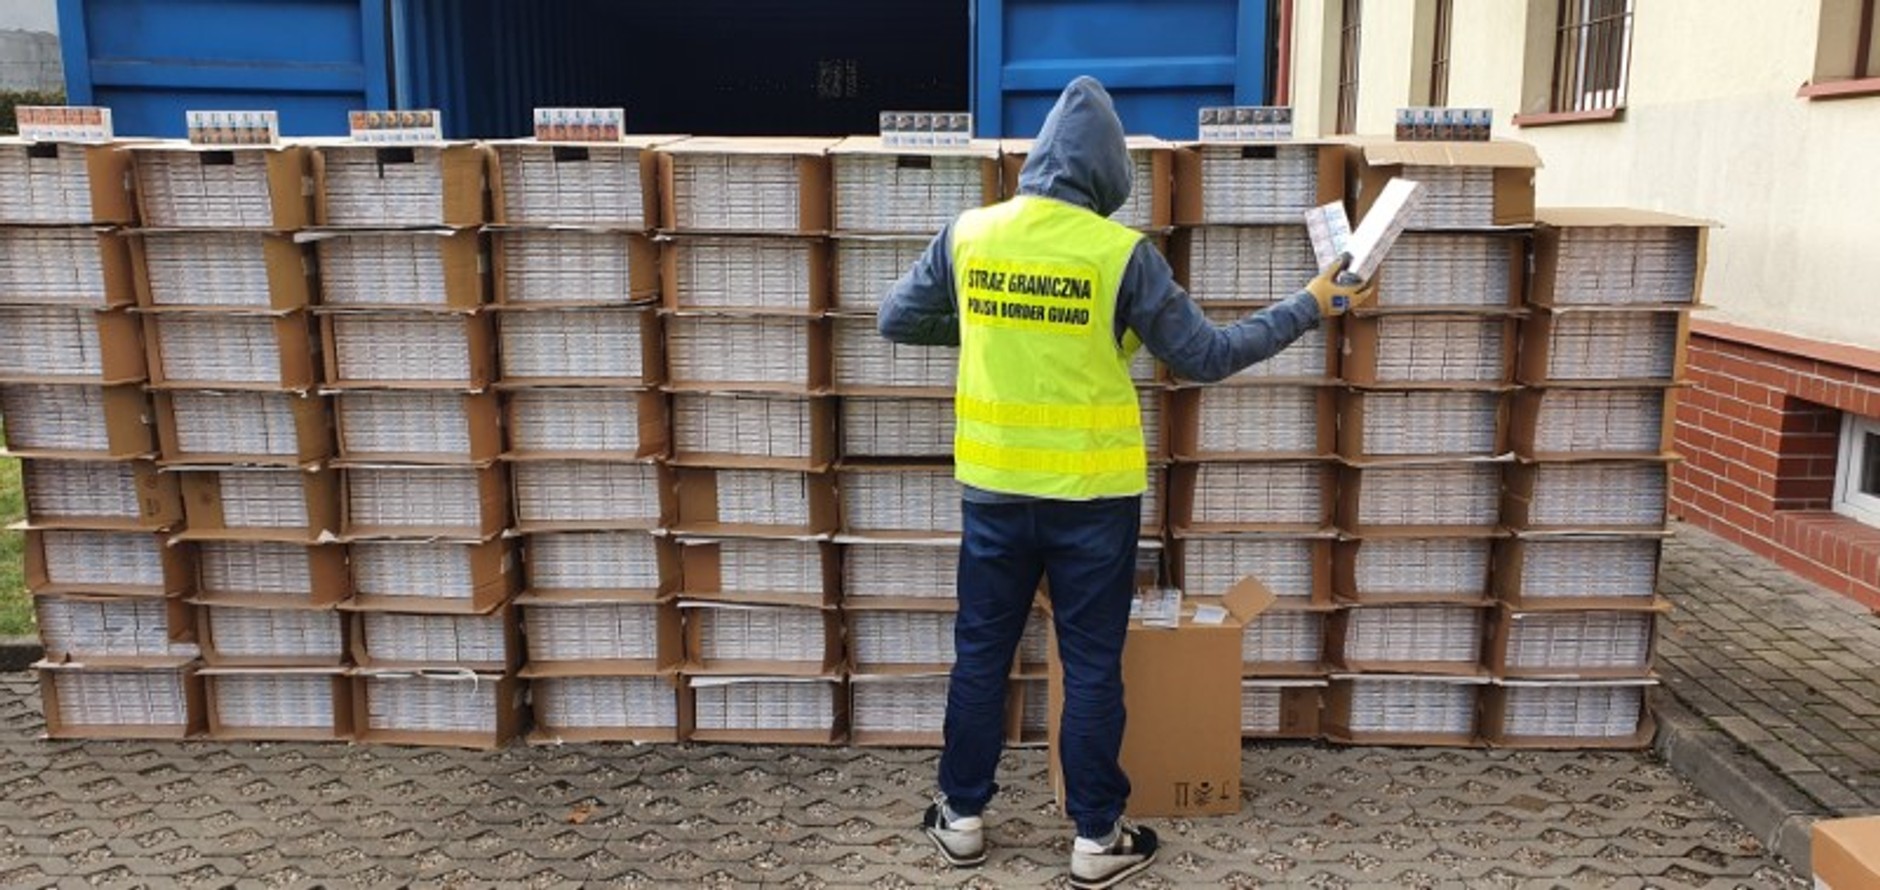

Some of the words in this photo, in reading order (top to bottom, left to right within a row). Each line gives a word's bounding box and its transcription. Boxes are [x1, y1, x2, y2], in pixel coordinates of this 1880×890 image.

[1008, 274, 1091, 299] GRANICZNA
[968, 298, 997, 316] POLISH
[1001, 302, 1044, 320] BORDER
[1048, 307, 1089, 325] GUARD
